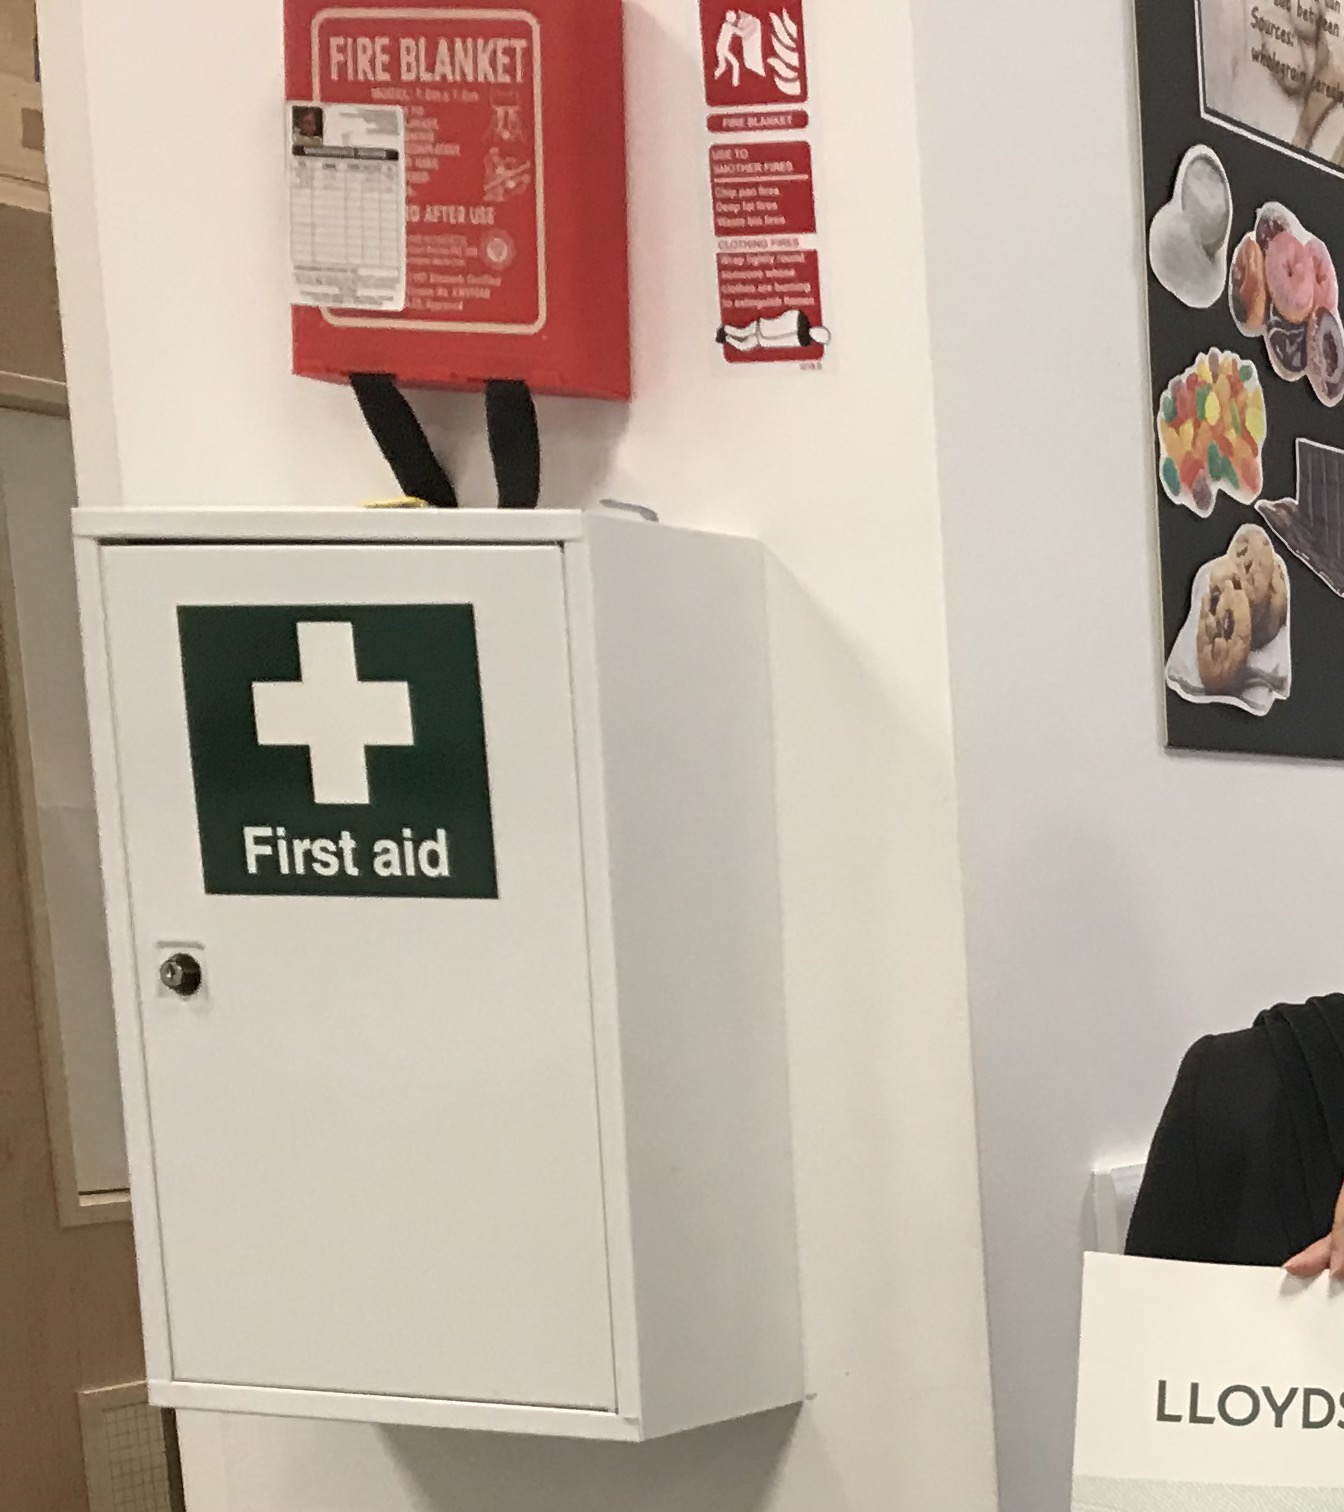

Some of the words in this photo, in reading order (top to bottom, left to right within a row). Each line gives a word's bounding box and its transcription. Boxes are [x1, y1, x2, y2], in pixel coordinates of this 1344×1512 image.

[1297, 0, 1339, 37] beteen
[329, 36, 391, 82] FIRE
[400, 37, 528, 83] BLANKET
[424, 204, 466, 224] AFTER
[718, 239, 769, 250] CLOTHING
[243, 826, 359, 876] First
[373, 828, 450, 878] aid
